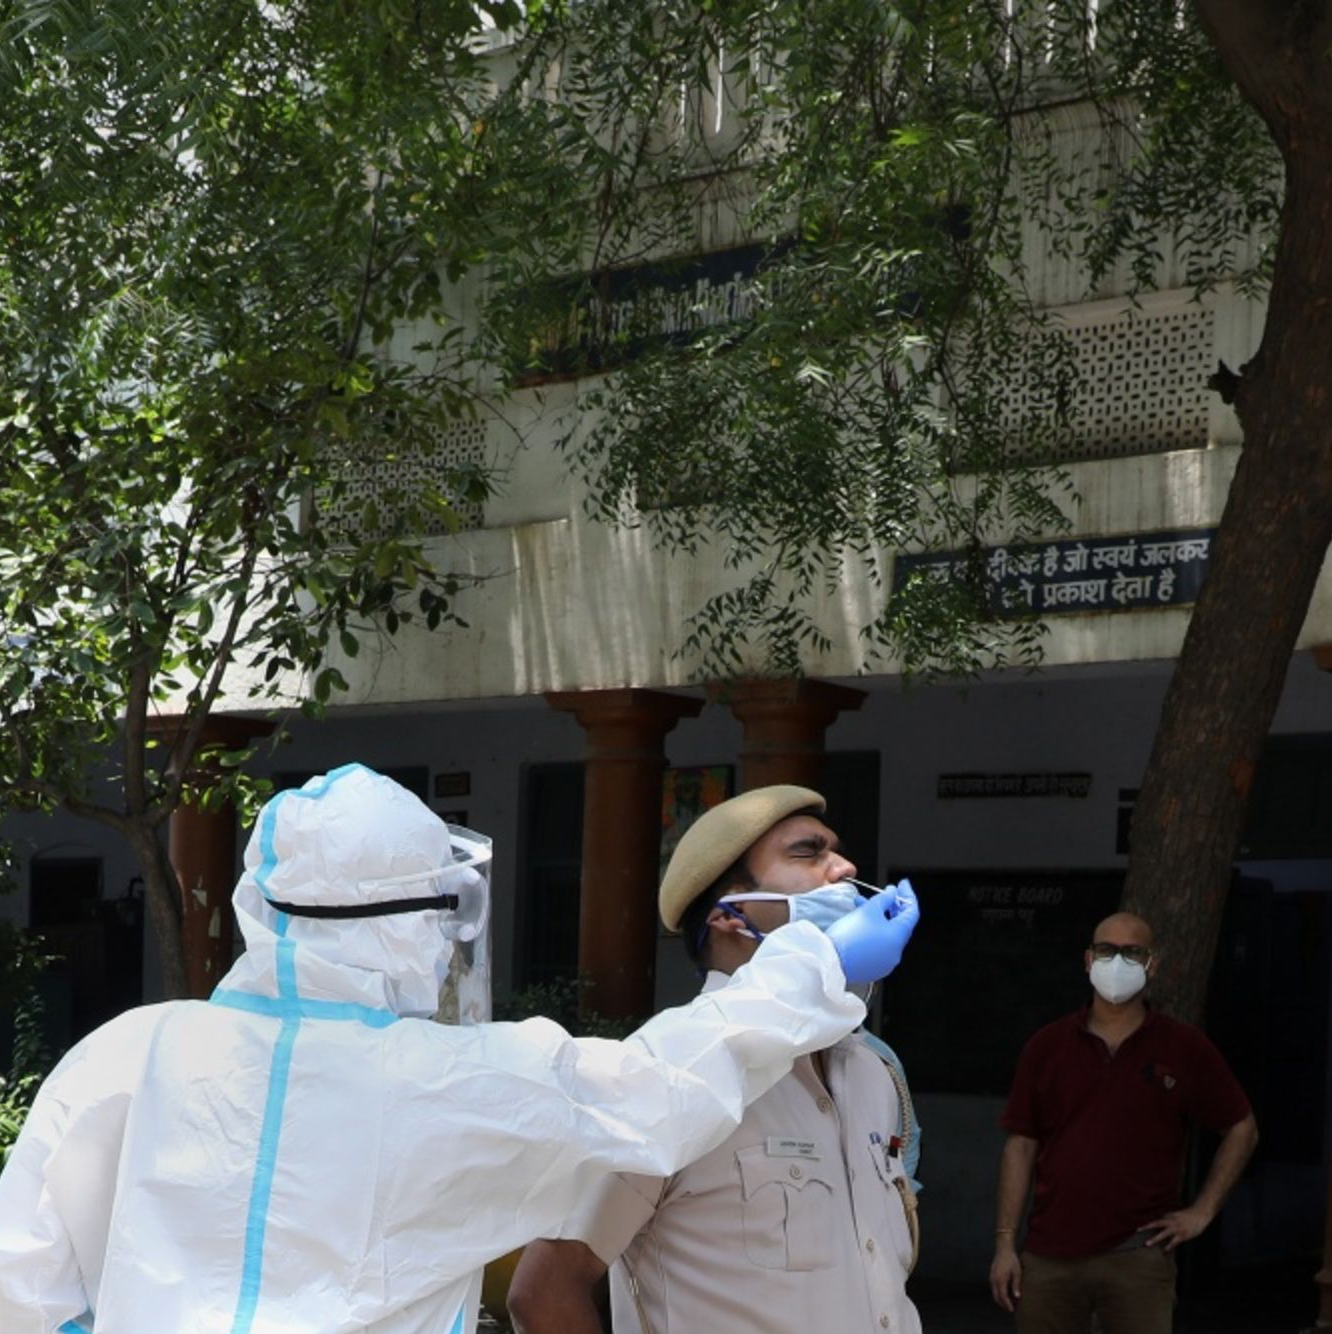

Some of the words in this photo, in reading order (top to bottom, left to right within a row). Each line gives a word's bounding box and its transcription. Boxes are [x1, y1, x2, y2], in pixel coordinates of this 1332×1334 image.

[1042, 545, 1060, 577] है
[1063, 543, 1089, 573] जो
[1092, 539, 1138, 570] स्वयं
[1139, 538, 1211, 567] जलकर
[1042, 579, 1108, 608] प्रकाश
[1111, 571, 1155, 605] देता
[1157, 567, 1177, 602] है
[1017, 886, 1064, 905] BOARD
